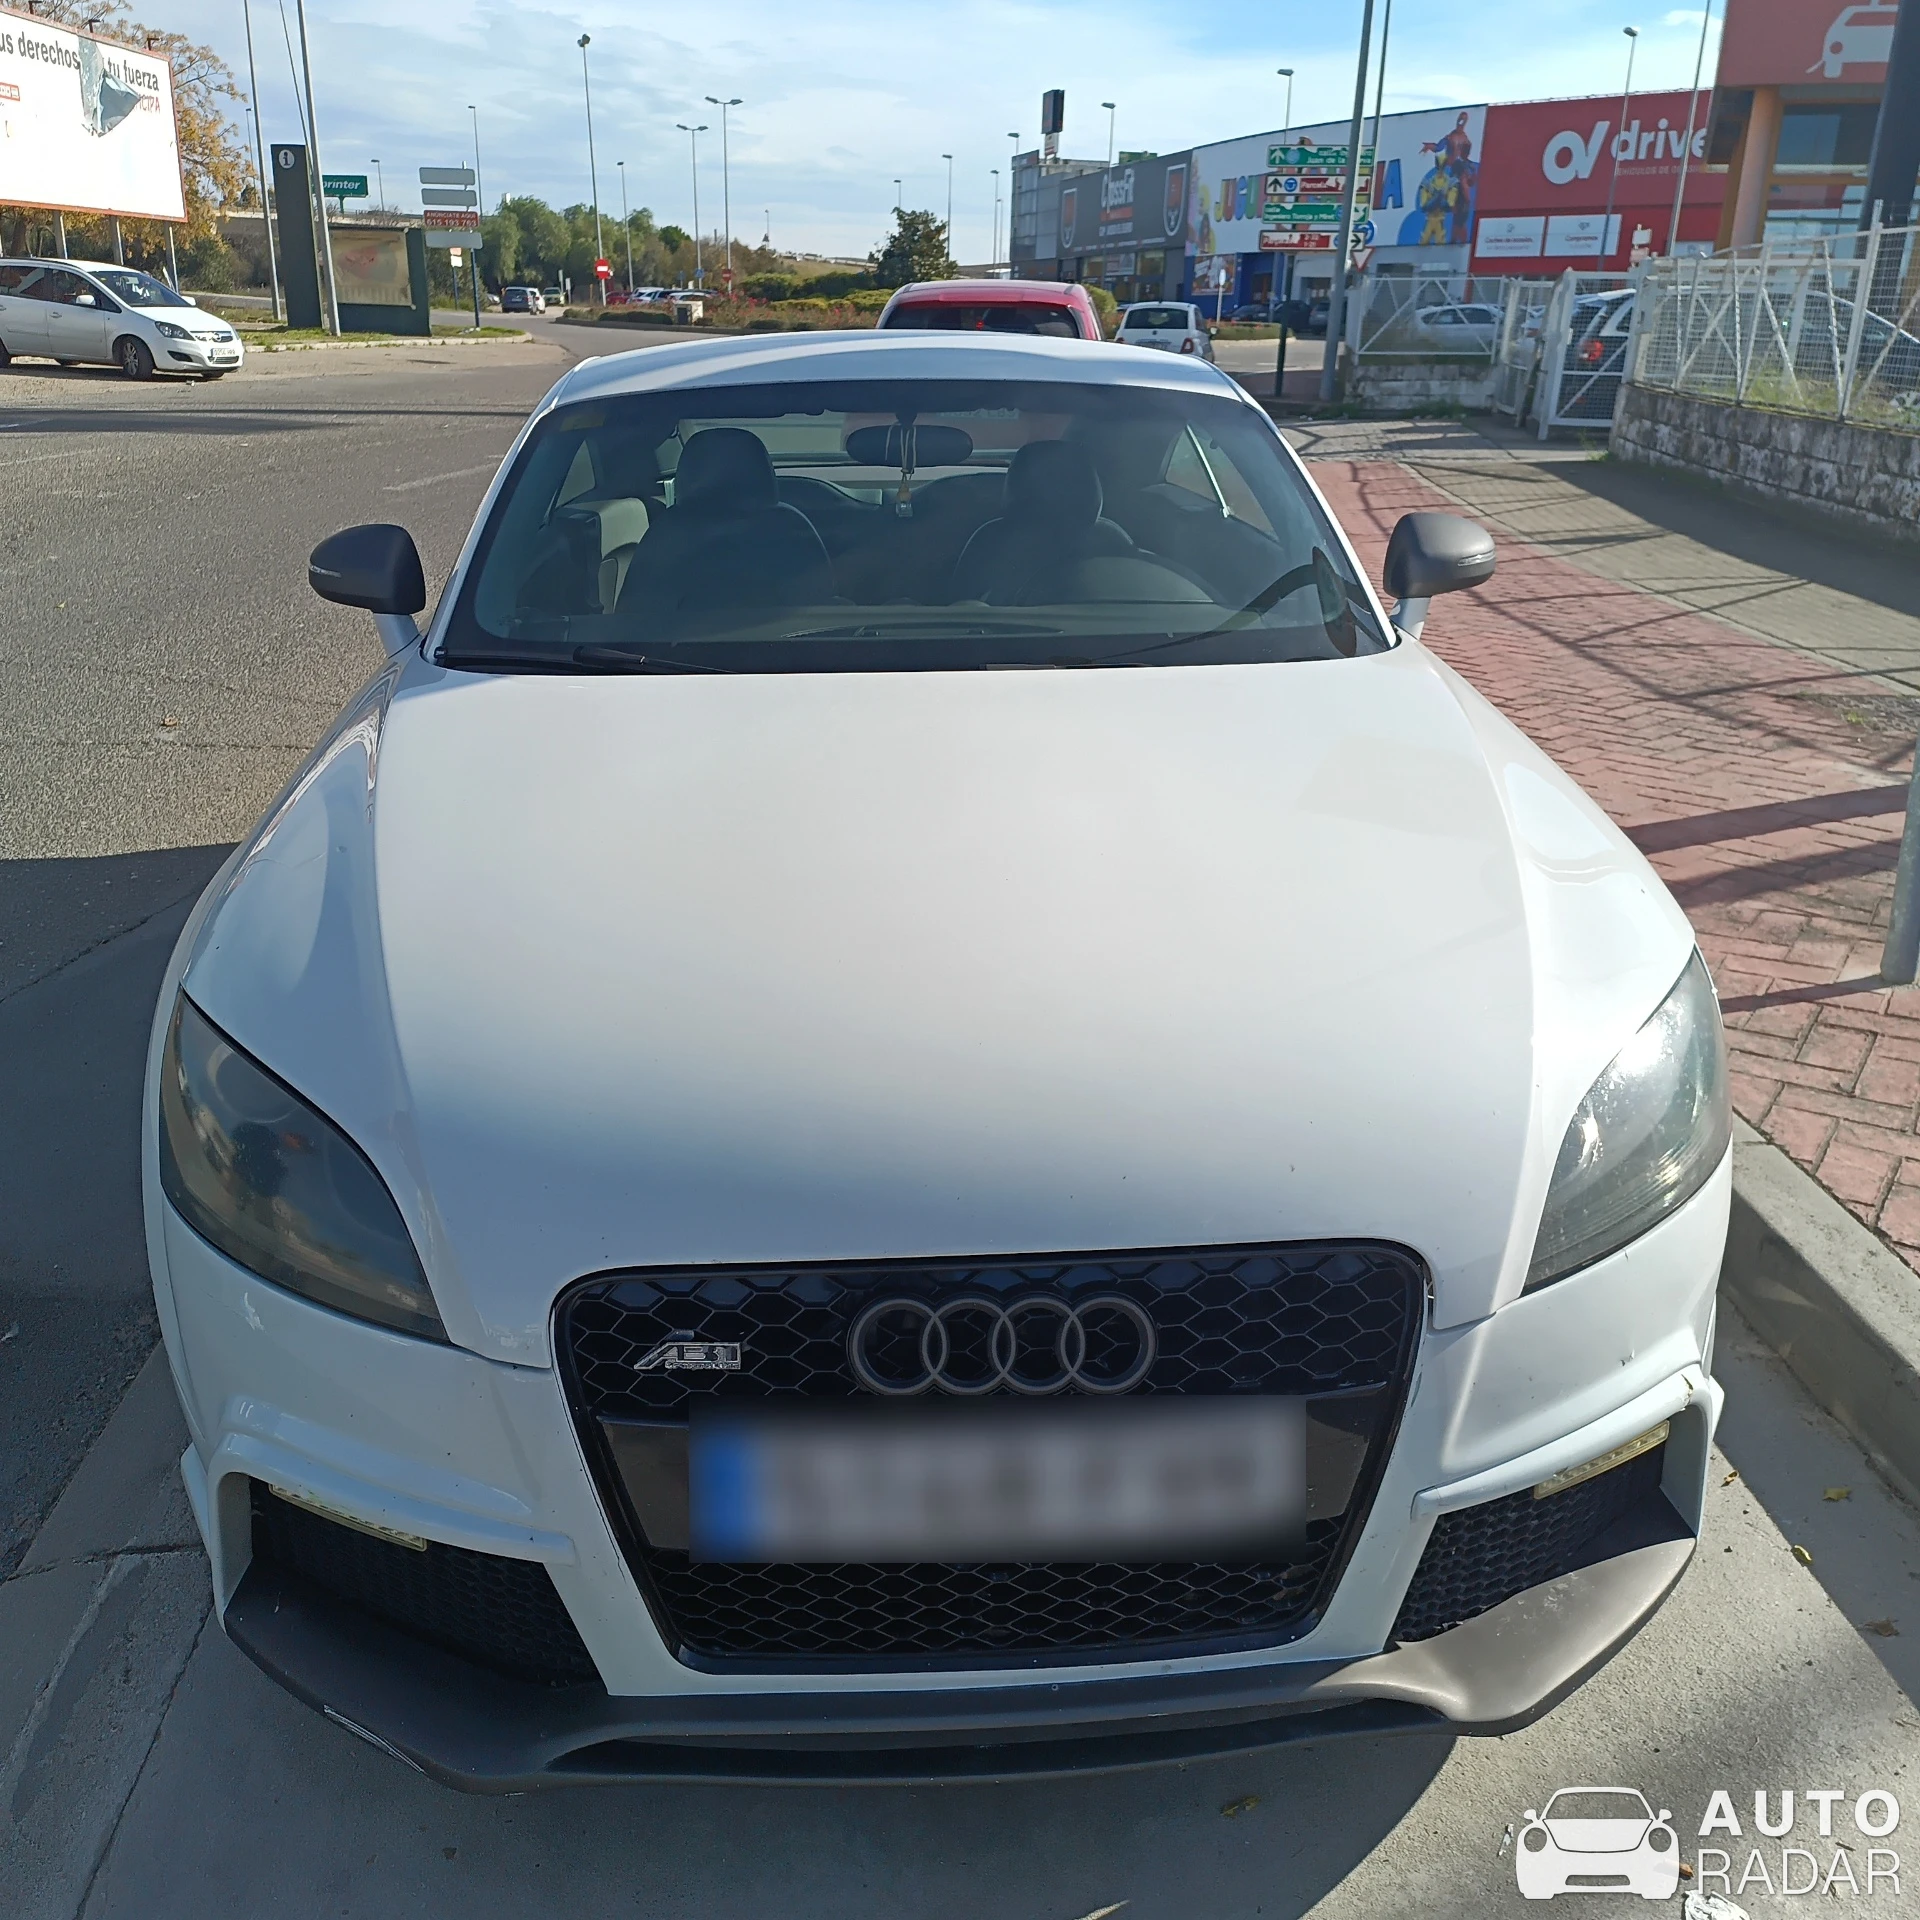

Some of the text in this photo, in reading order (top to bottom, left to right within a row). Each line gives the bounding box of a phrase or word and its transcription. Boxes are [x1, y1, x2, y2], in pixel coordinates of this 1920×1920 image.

[0, 32, 14, 55] us
[124, 59, 160, 92] fuerza
[322, 180, 361, 190] printer
